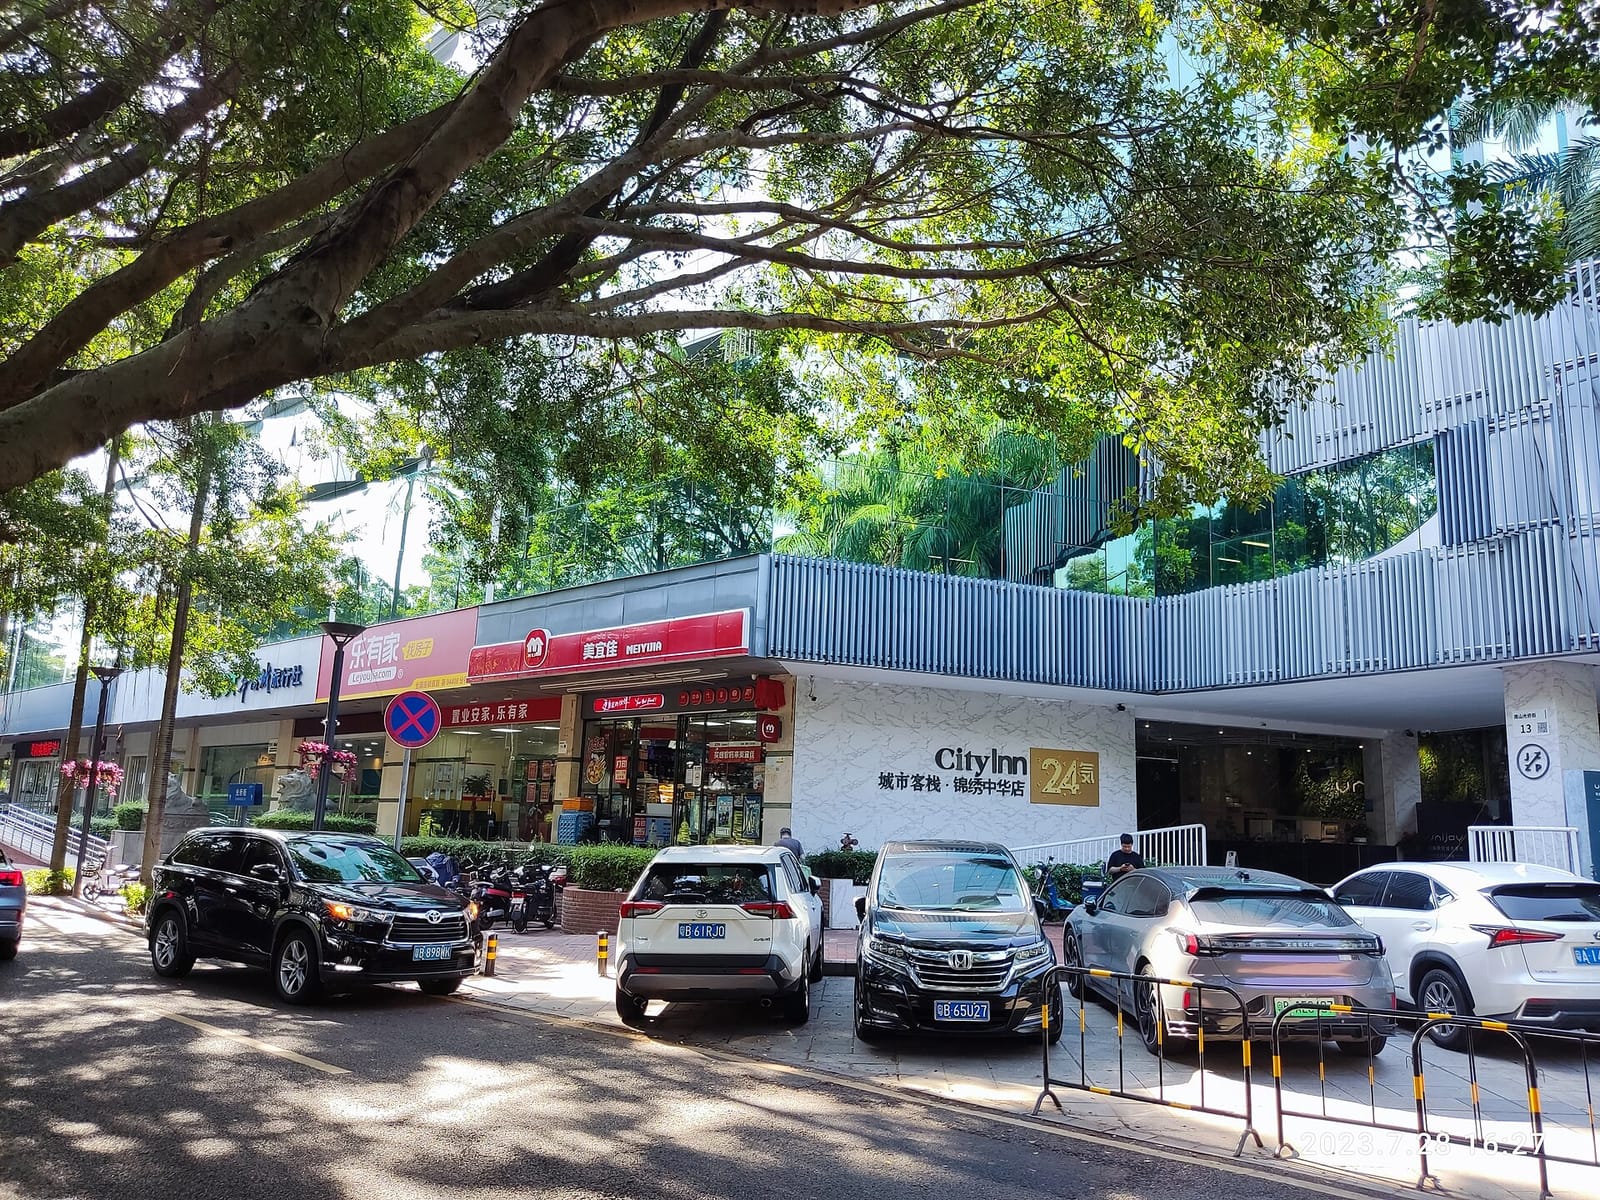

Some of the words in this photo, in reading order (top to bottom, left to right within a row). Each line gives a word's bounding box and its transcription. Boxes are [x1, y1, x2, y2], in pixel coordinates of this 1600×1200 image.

[349, 632, 400, 669] 乐有家
[406, 640, 432, 658] 找房子
[583, 640, 618, 660] 美宜佳
[626, 641, 662, 655] MEIYIJIA
[1520, 723, 1532, 734] 13
[934, 747, 1028, 777] CityInn
